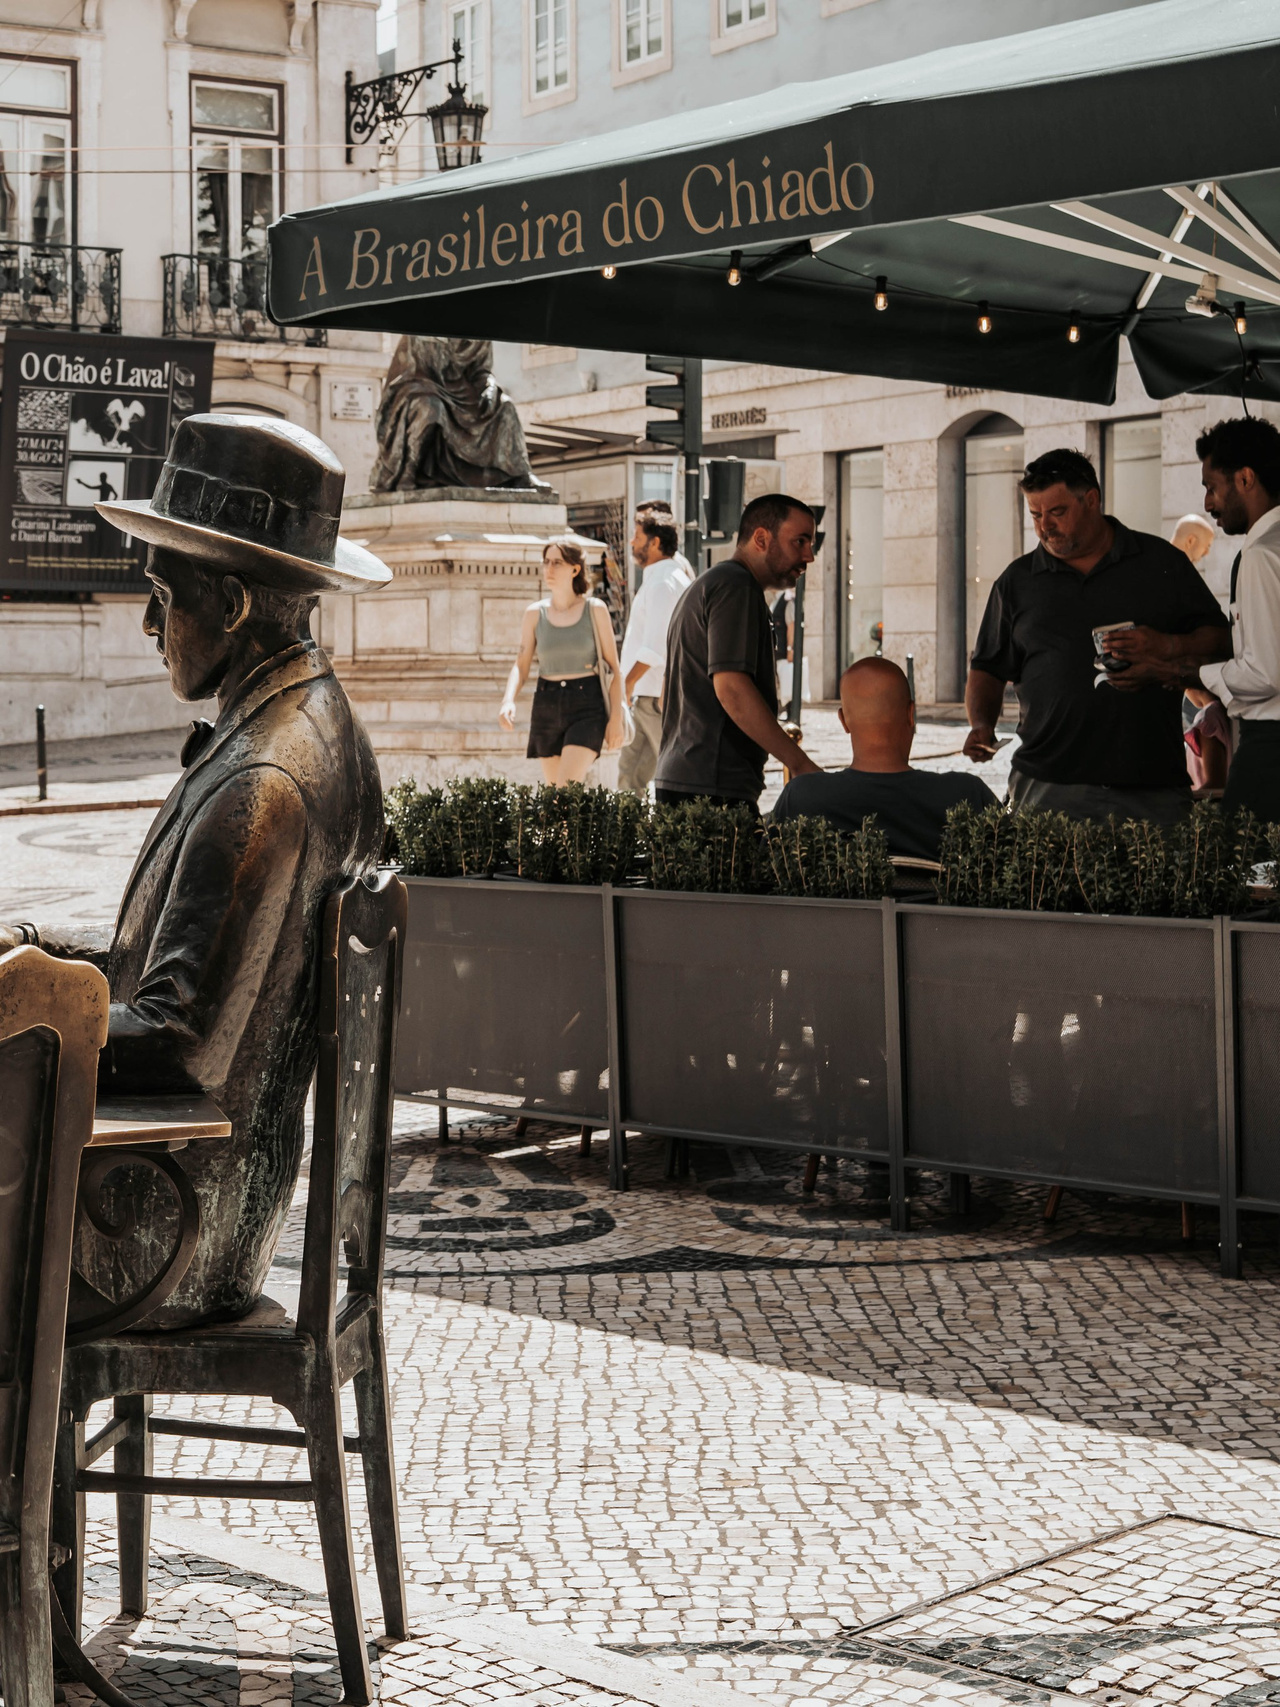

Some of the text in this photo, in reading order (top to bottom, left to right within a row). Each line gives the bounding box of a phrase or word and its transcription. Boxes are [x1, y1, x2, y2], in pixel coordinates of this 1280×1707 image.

[299, 140, 874, 301] A Brasileira do Chiado
[20, 352, 169, 389] O Chão é Lava!
